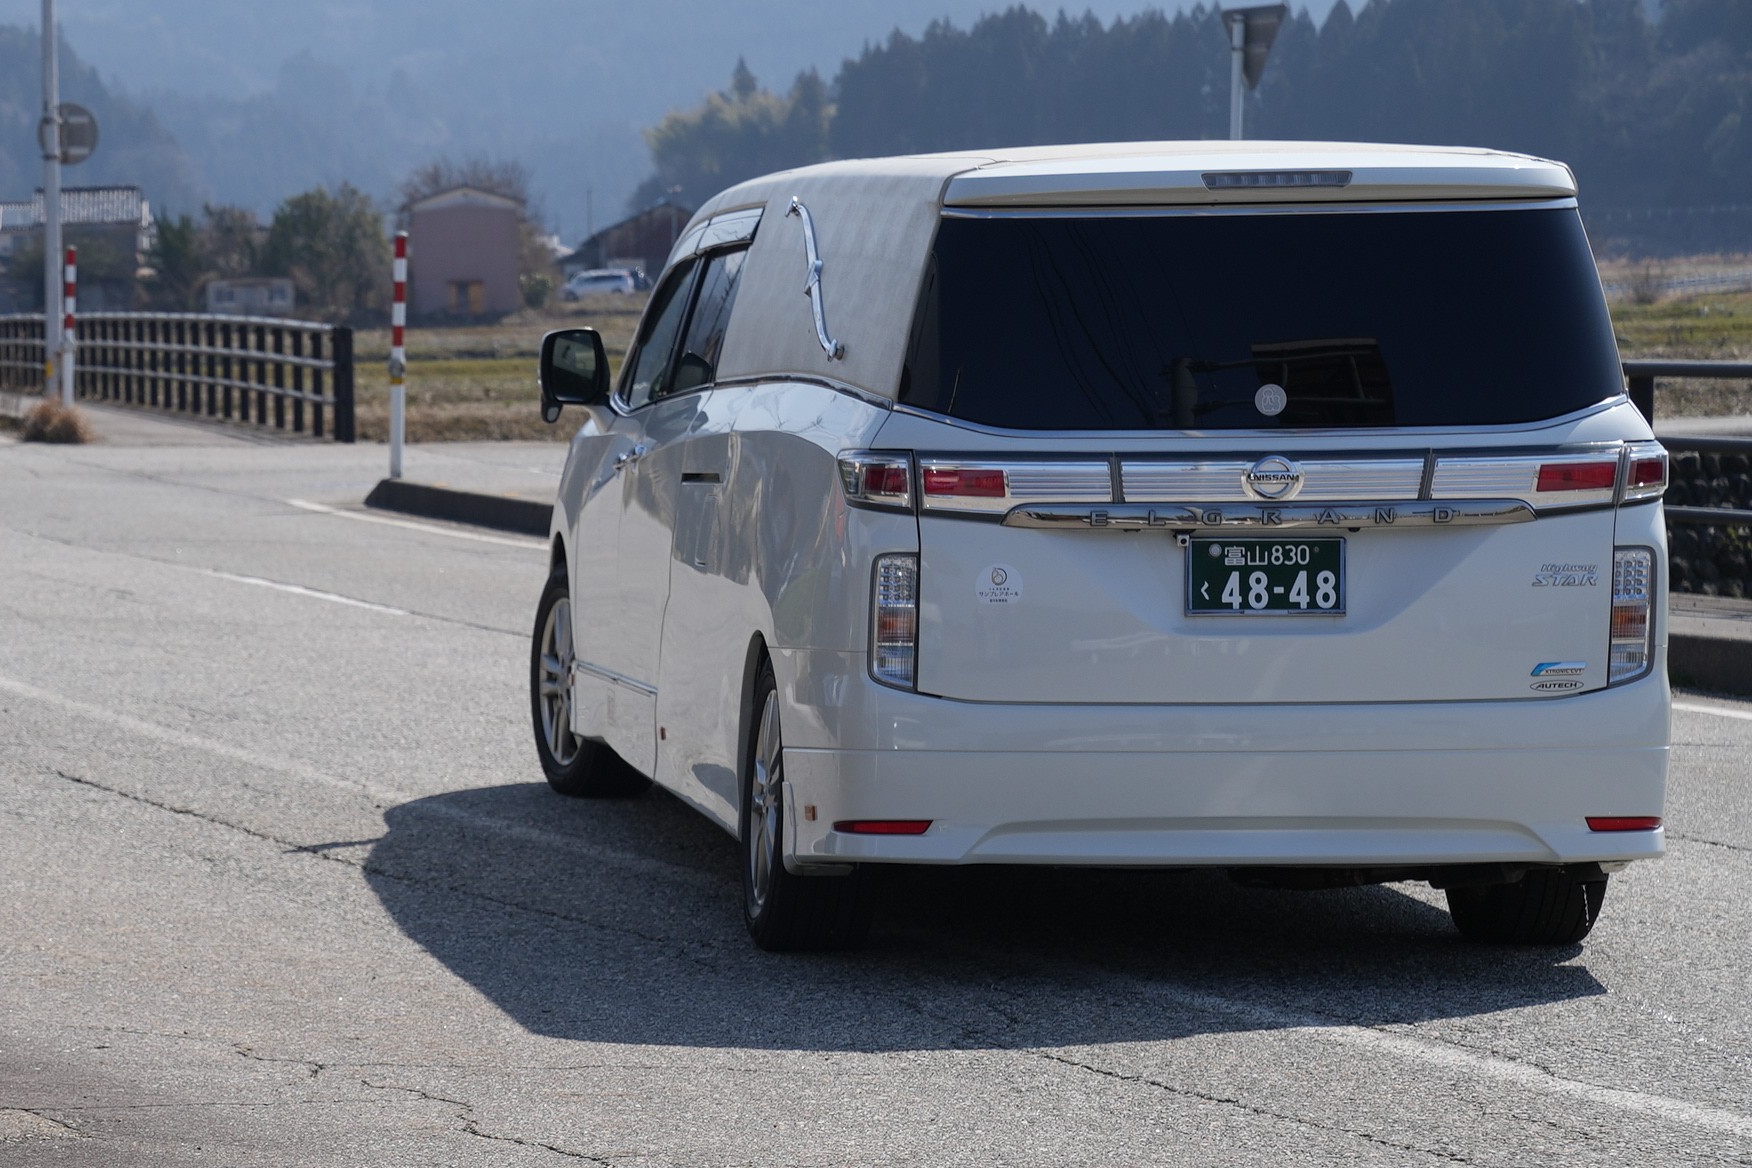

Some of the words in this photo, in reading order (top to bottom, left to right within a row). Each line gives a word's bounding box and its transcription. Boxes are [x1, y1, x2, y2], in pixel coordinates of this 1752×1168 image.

[1253, 473, 1295, 481] NISSAN
[1090, 506, 1455, 528] ELGRAND
[1541, 563, 1598, 575] Highway
[1531, 574, 1598, 587] STAR
[1200, 580, 1210, 601] く
[1221, 570, 1337, 610] 48-48
[1535, 682, 1578, 690] AUTECH
